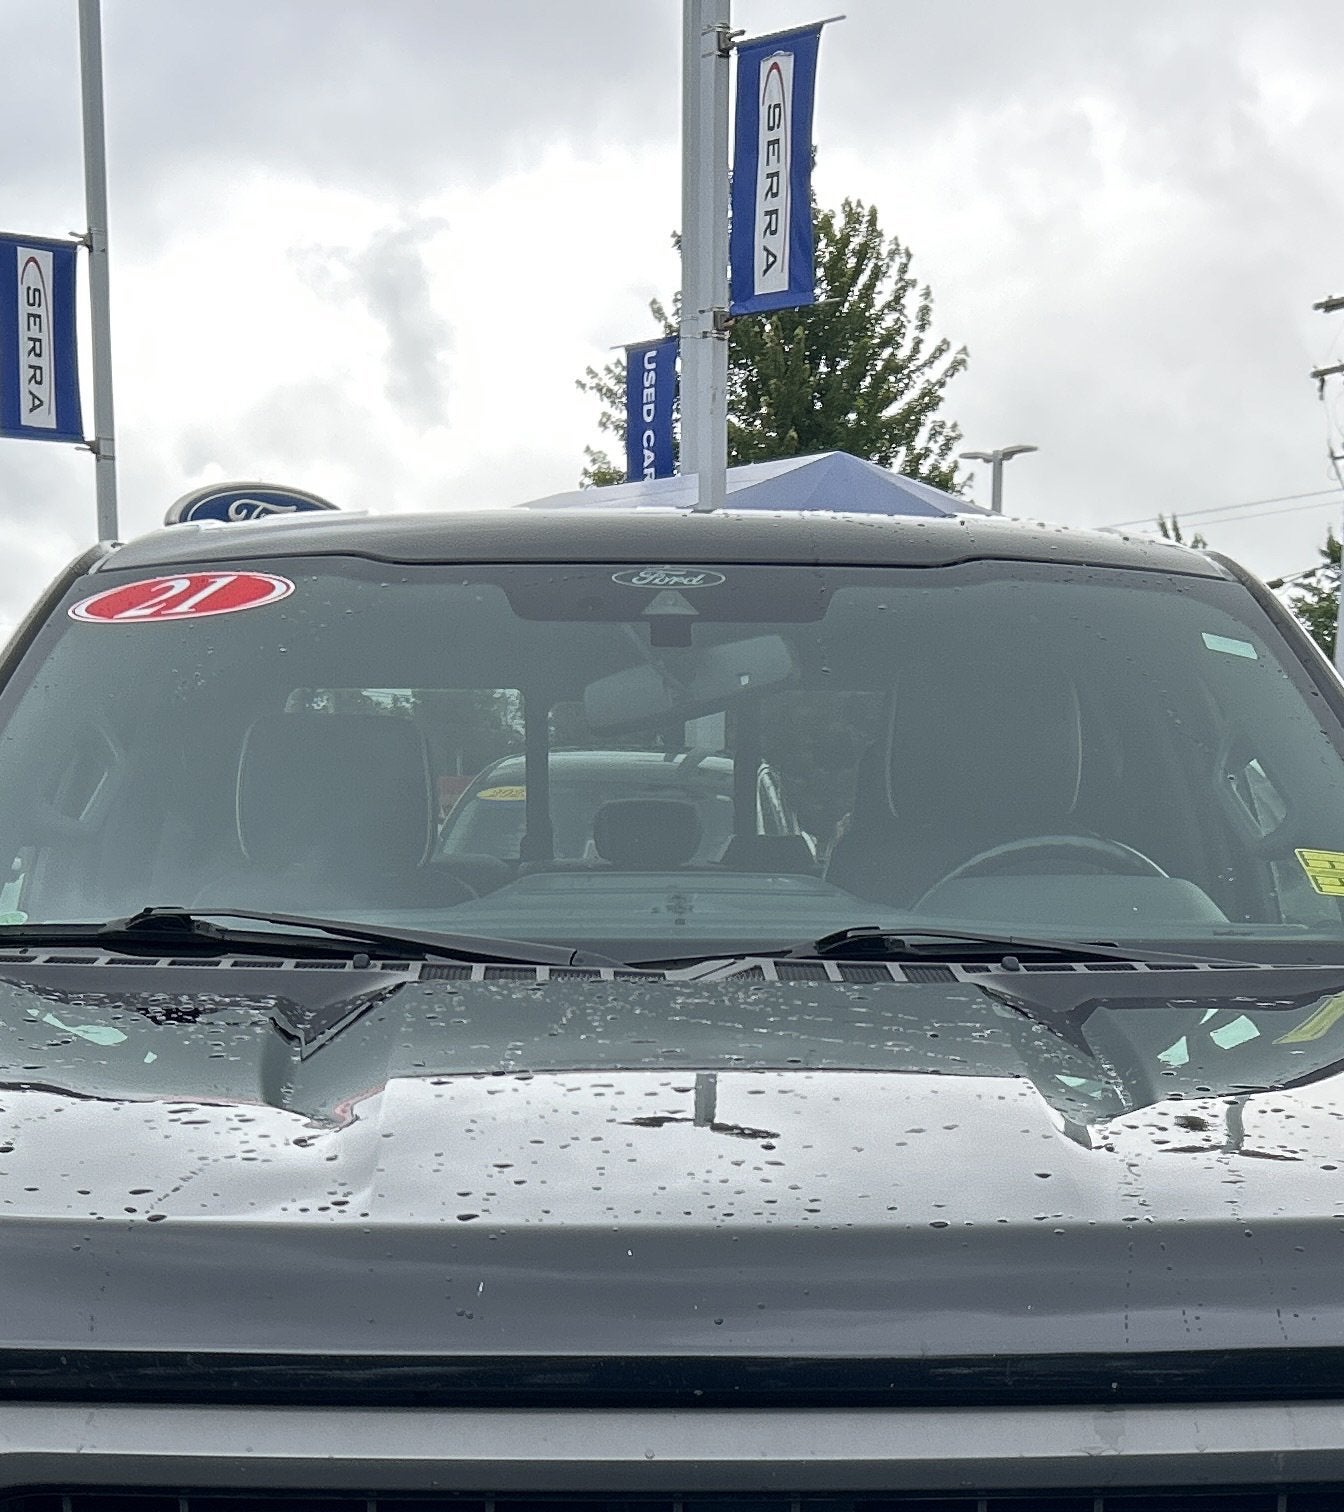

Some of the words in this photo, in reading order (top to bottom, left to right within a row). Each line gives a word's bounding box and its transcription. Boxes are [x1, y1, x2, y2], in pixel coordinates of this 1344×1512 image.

[761, 103, 782, 277] SERRA
[26, 285, 44, 414] SERRA
[642, 350, 657, 423] USED
[642, 429, 656, 481] CAR
[112, 574, 238, 619] 21
[631, 567, 706, 585] Ford
